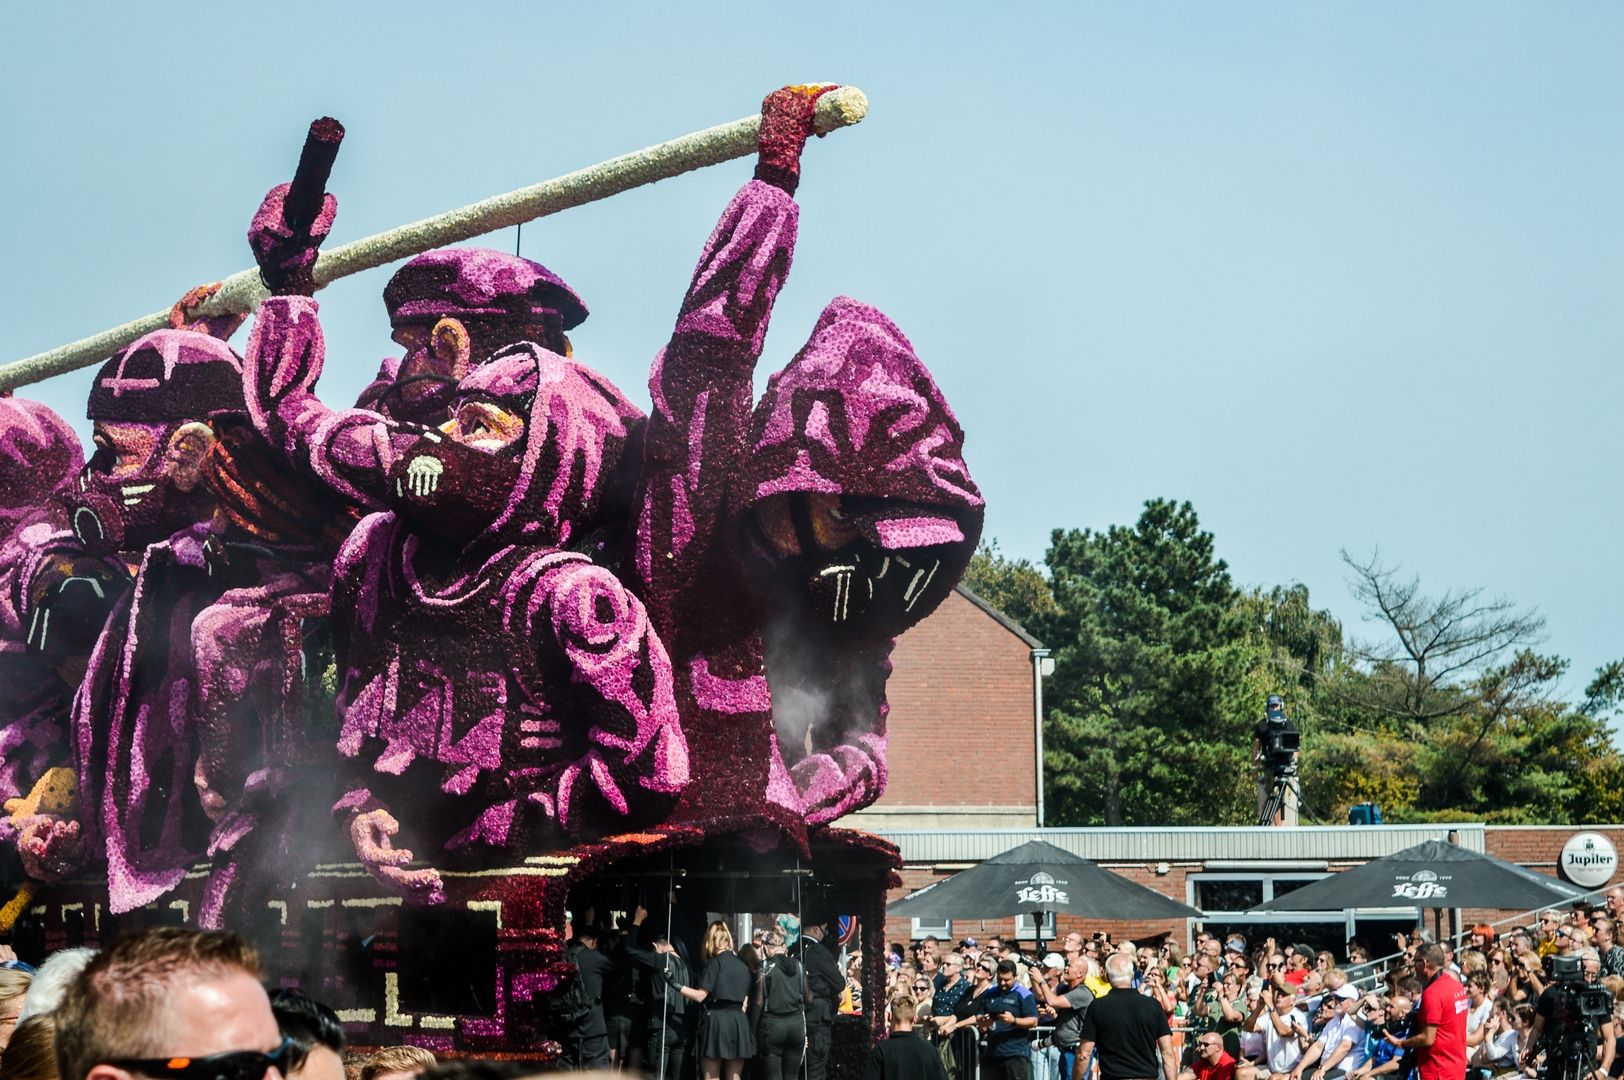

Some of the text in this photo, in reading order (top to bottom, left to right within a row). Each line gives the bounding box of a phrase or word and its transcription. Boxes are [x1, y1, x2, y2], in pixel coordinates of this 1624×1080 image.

[1568, 853, 1613, 867] Jupiler
[1016, 884, 1068, 904] Leffe
[1392, 881, 1448, 900] Leffe
